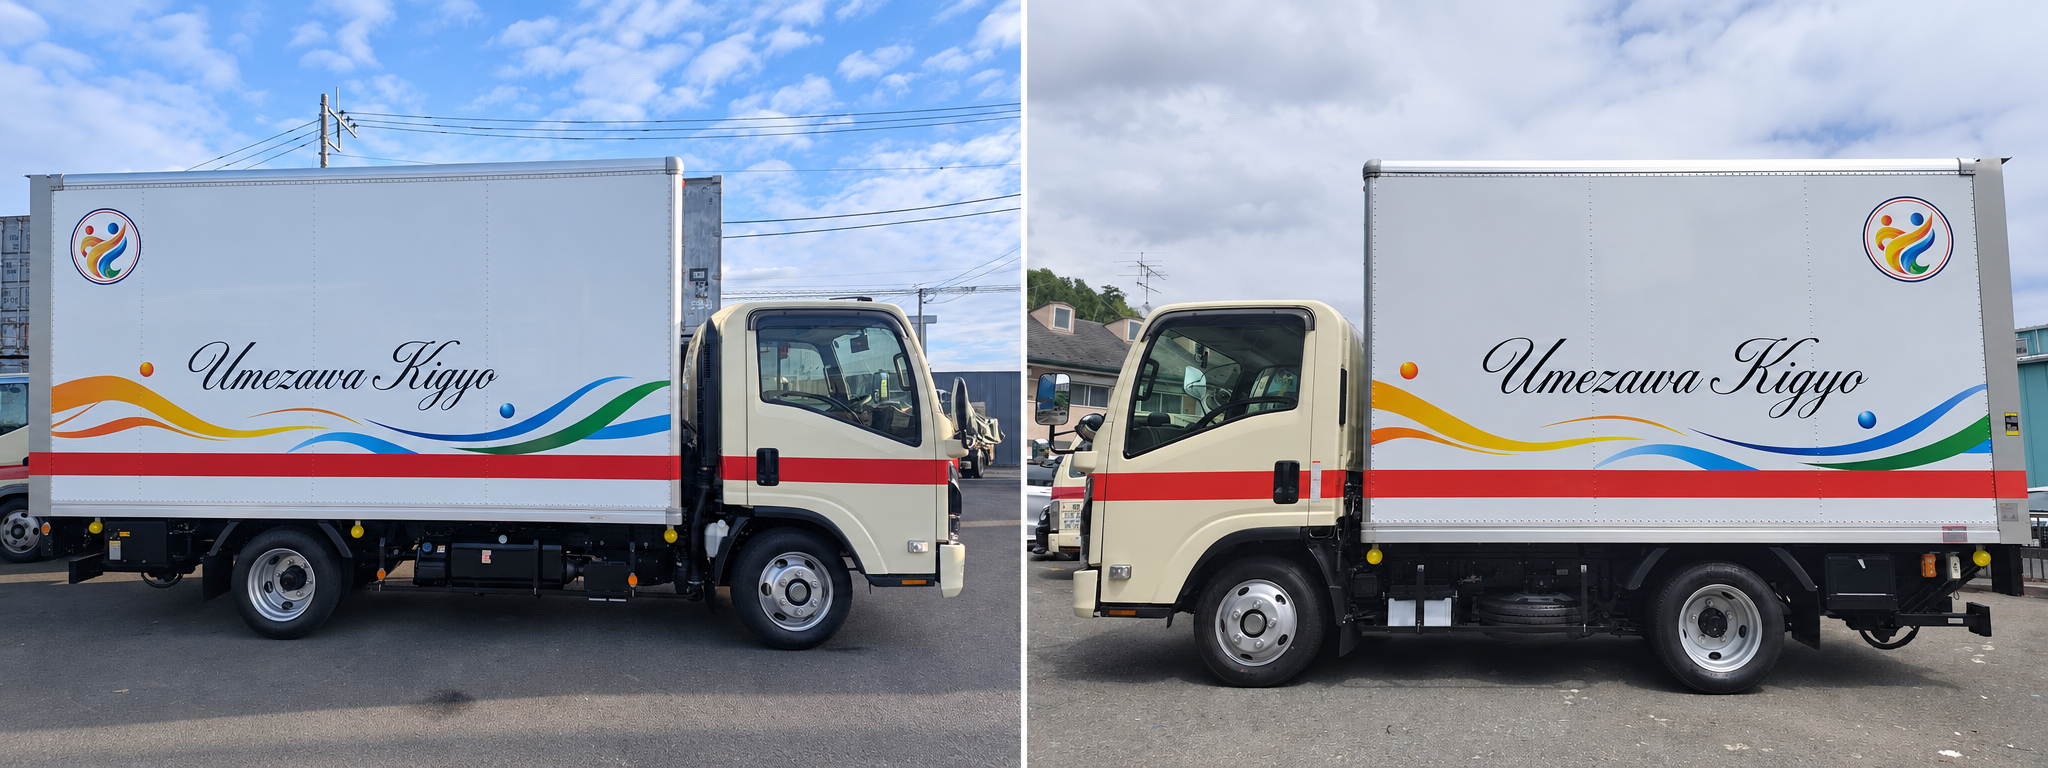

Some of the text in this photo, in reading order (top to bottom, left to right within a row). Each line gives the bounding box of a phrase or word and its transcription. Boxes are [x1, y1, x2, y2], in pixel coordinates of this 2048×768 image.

[187, 340, 499, 411] Umezawa Kigyo
[1483, 337, 1869, 418] Umezawa Kigyo
